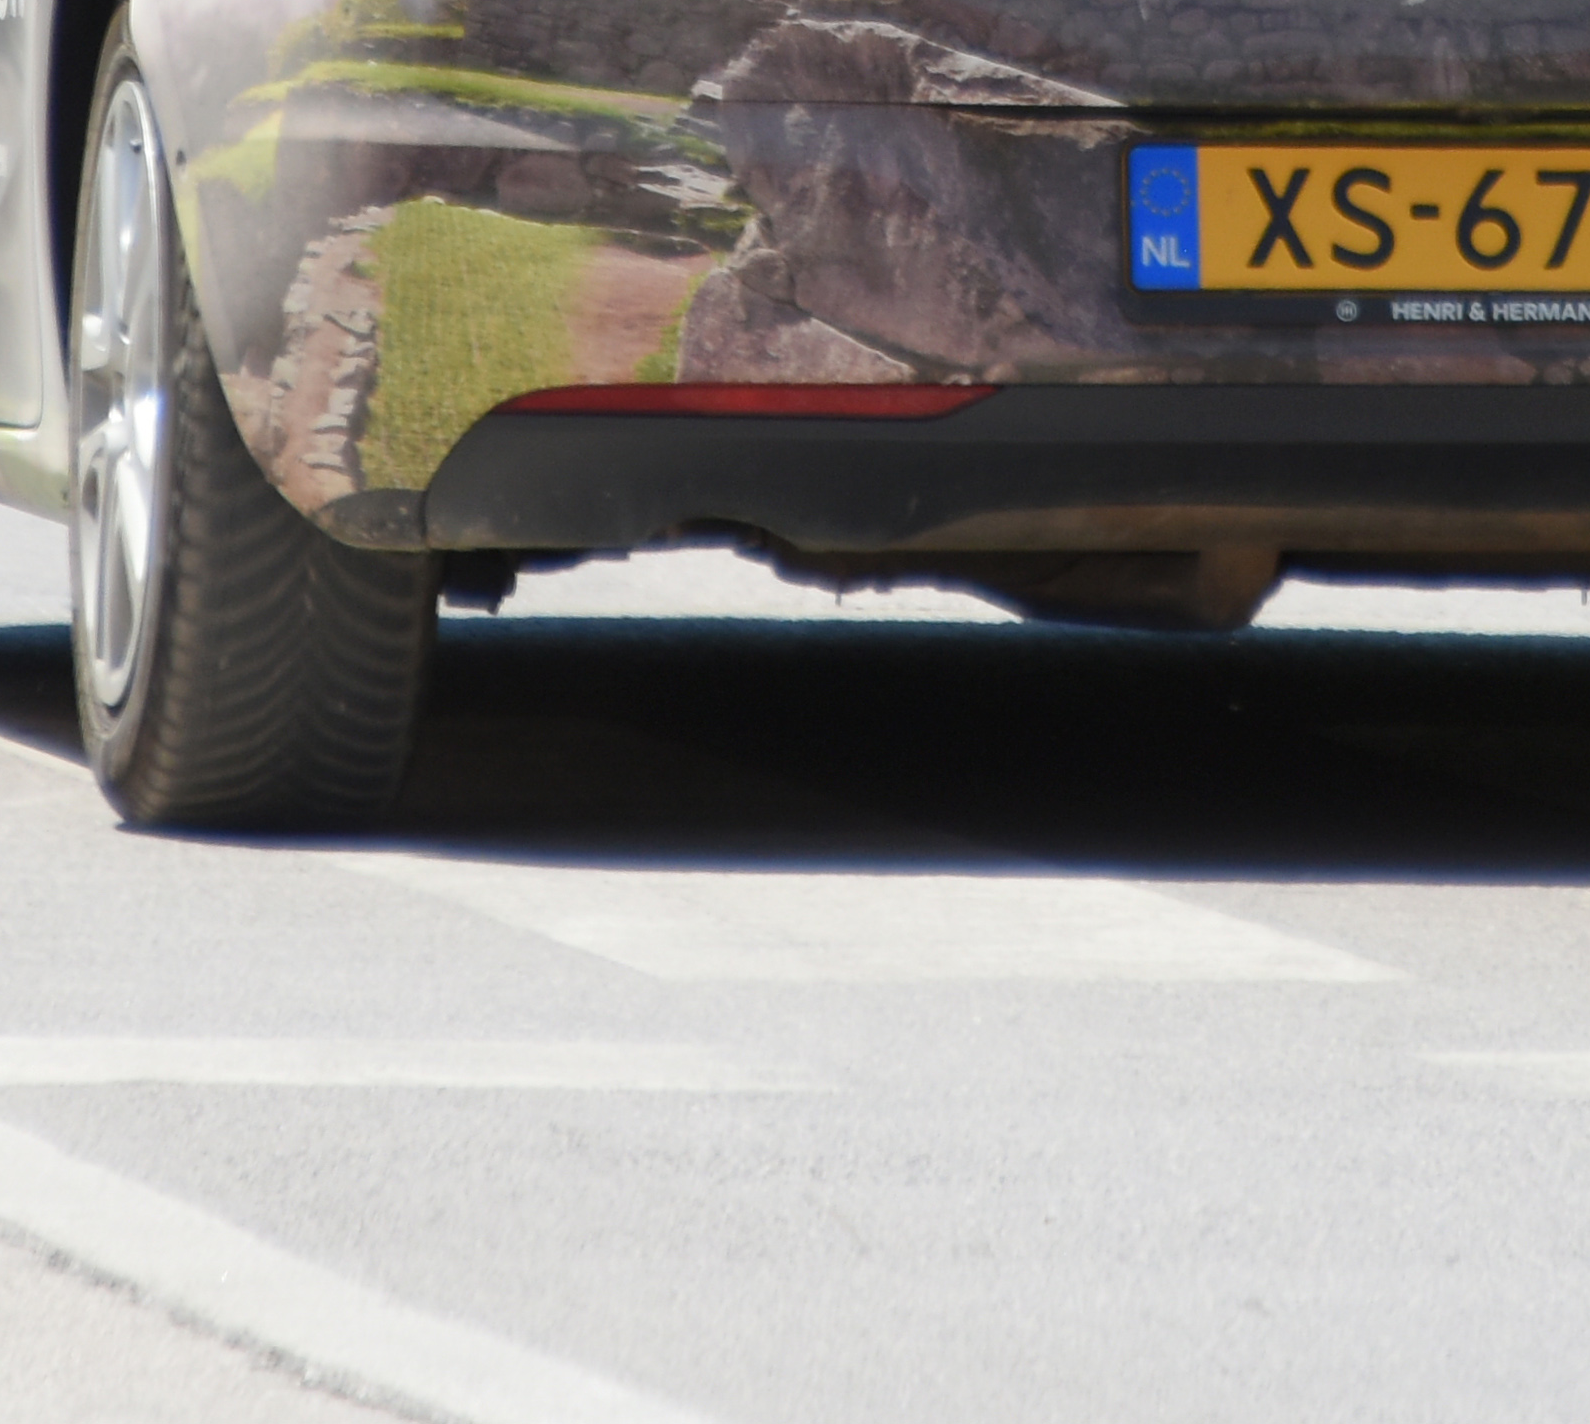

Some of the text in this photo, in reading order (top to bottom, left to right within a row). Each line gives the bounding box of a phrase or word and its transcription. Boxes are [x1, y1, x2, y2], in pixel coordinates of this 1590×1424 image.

[1141, 235, 1192, 270] NL
[1391, 301, 1463, 322] HENRI
[1468, 302, 1487, 322] &
